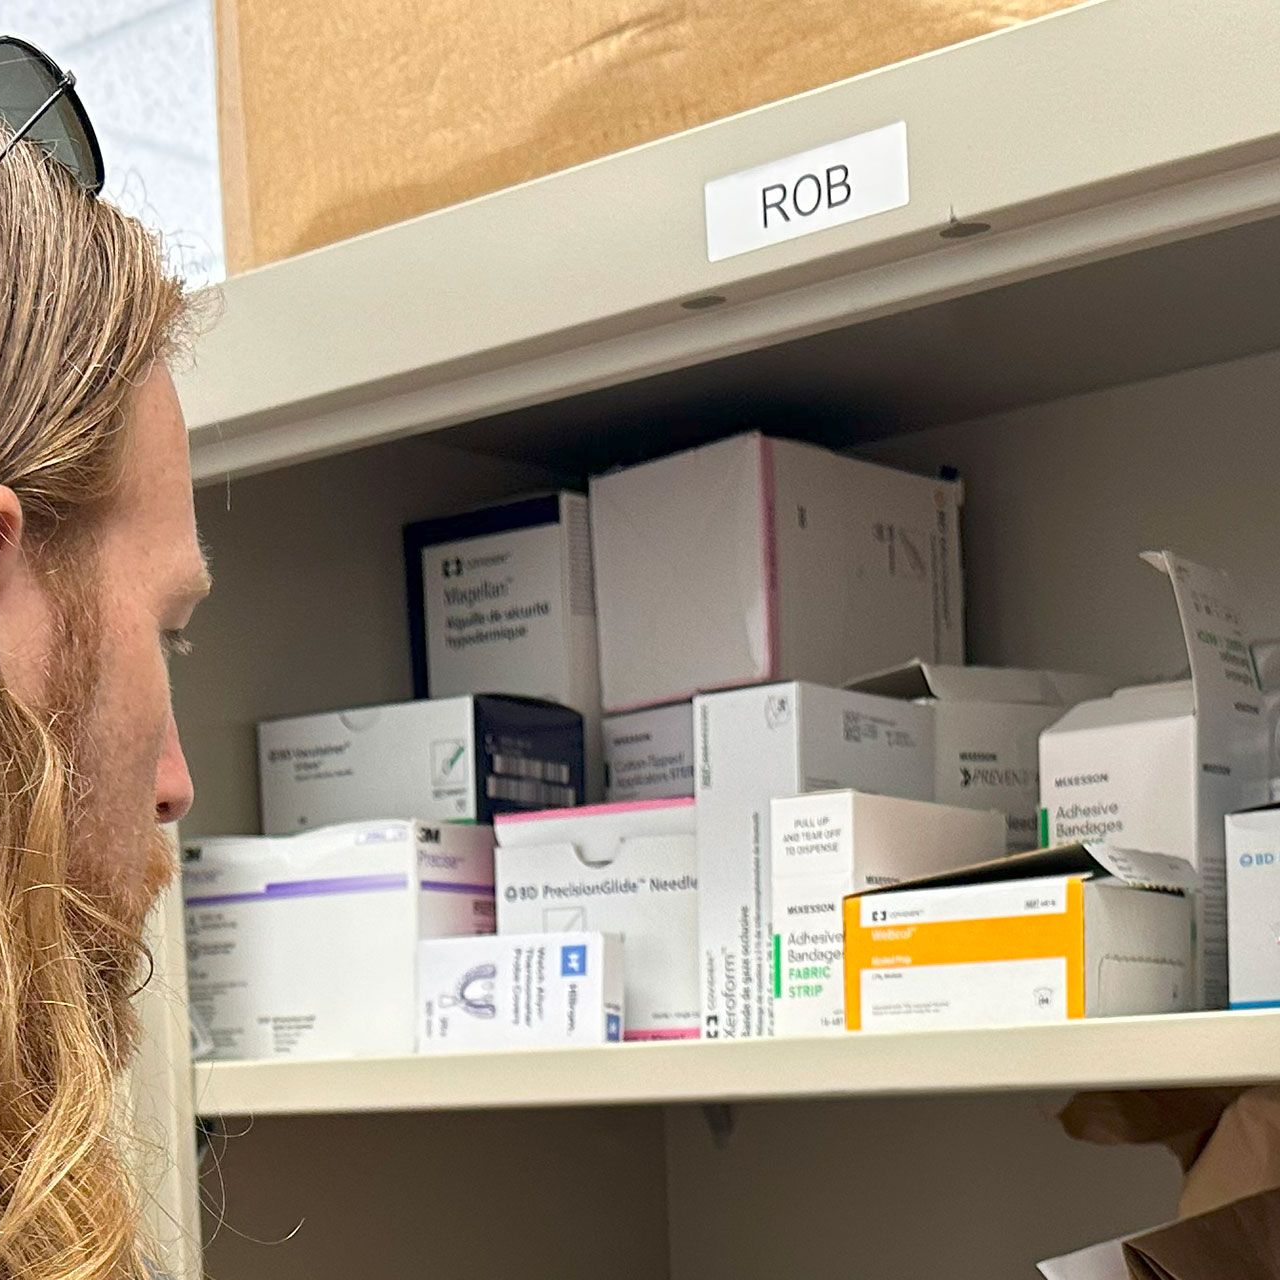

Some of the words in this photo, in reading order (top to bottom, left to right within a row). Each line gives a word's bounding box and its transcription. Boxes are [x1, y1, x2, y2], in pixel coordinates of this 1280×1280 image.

[761, 164, 852, 229] ROB
[1056, 802, 1119, 819] Adhesive
[794, 818, 814, 828] PULL
[1056, 819, 1123, 838] Bandages
[420, 827, 440, 843] 3M
[785, 845, 796, 856] TO
[797, 843, 839, 856] DISPENSE
[1256, 854, 1274, 866] BD
[788, 930, 844, 946] Adhesive
[788, 966, 831, 980] FABRIC
[789, 985, 823, 998] STRIP
